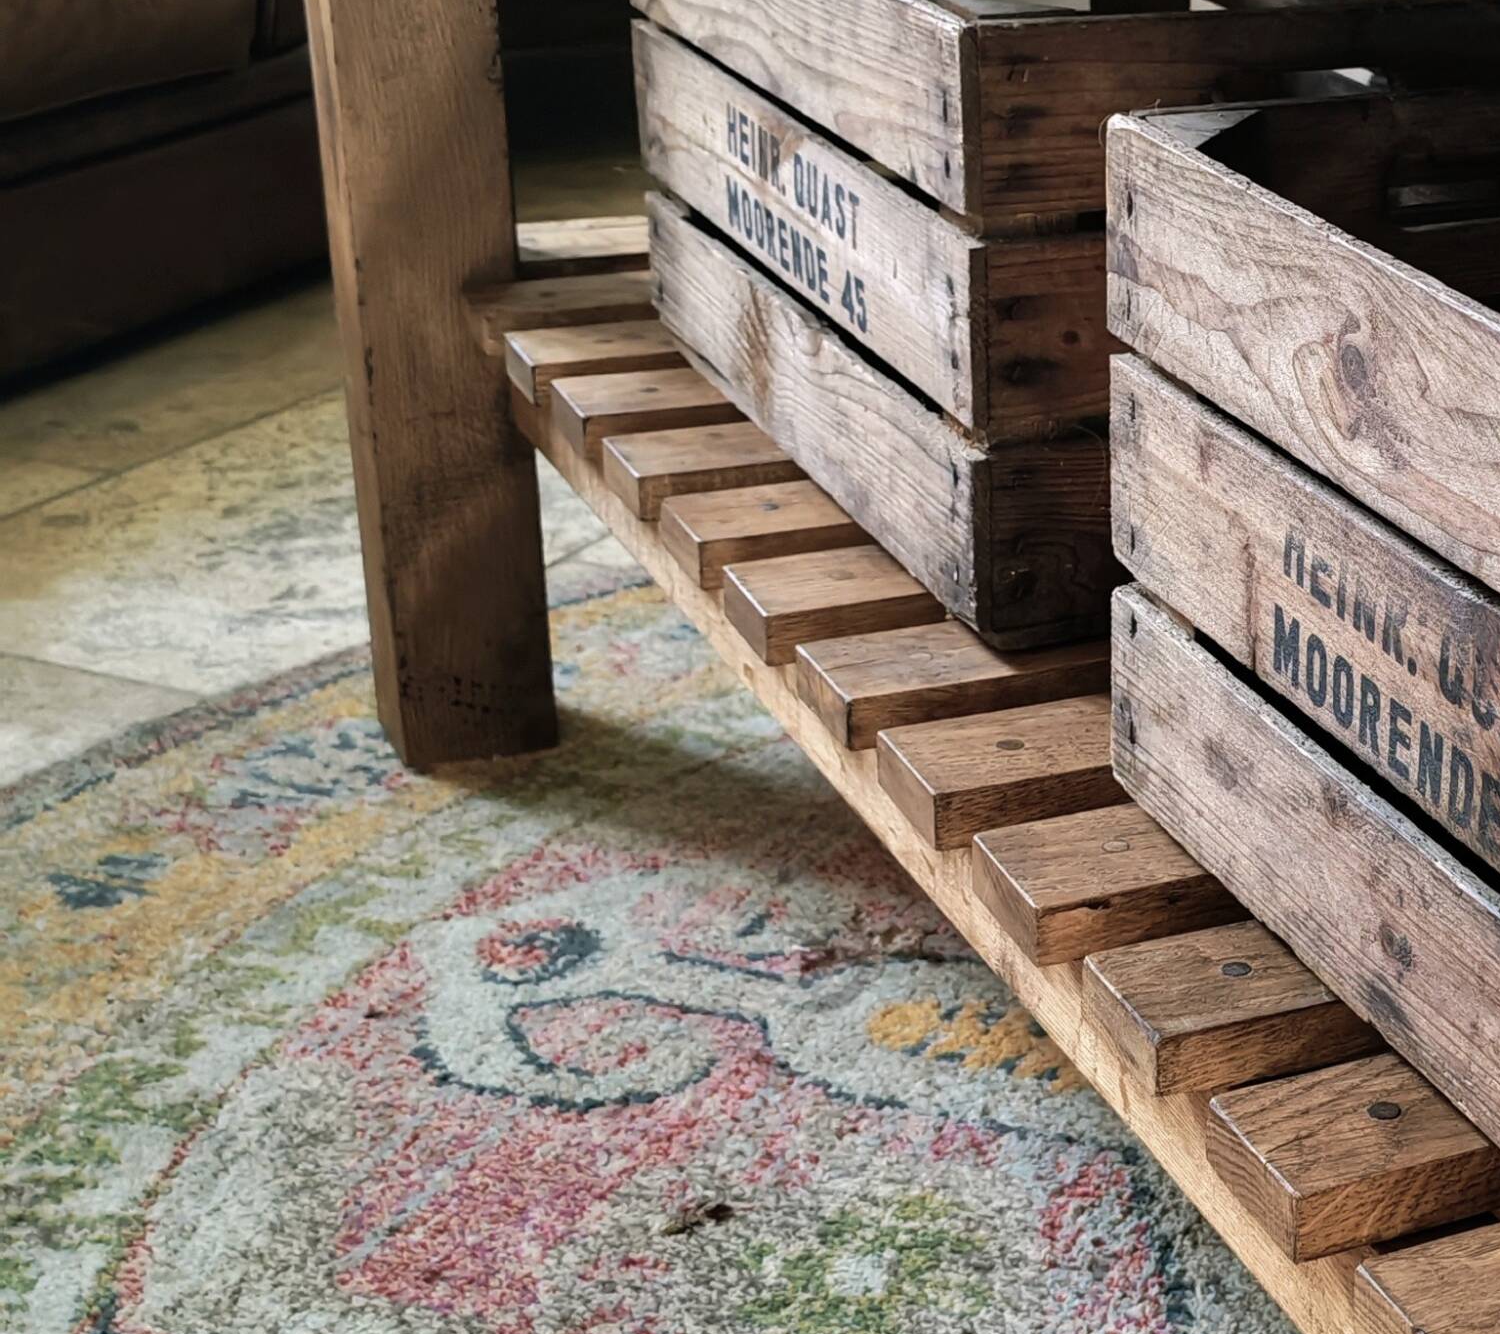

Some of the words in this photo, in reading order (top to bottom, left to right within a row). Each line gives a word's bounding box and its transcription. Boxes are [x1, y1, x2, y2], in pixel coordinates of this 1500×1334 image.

[727, 101, 786, 197] HEINR.
[793, 152, 860, 250] QUAST
[726, 174, 830, 305] MOORENDE
[841, 270, 868, 334] 45
